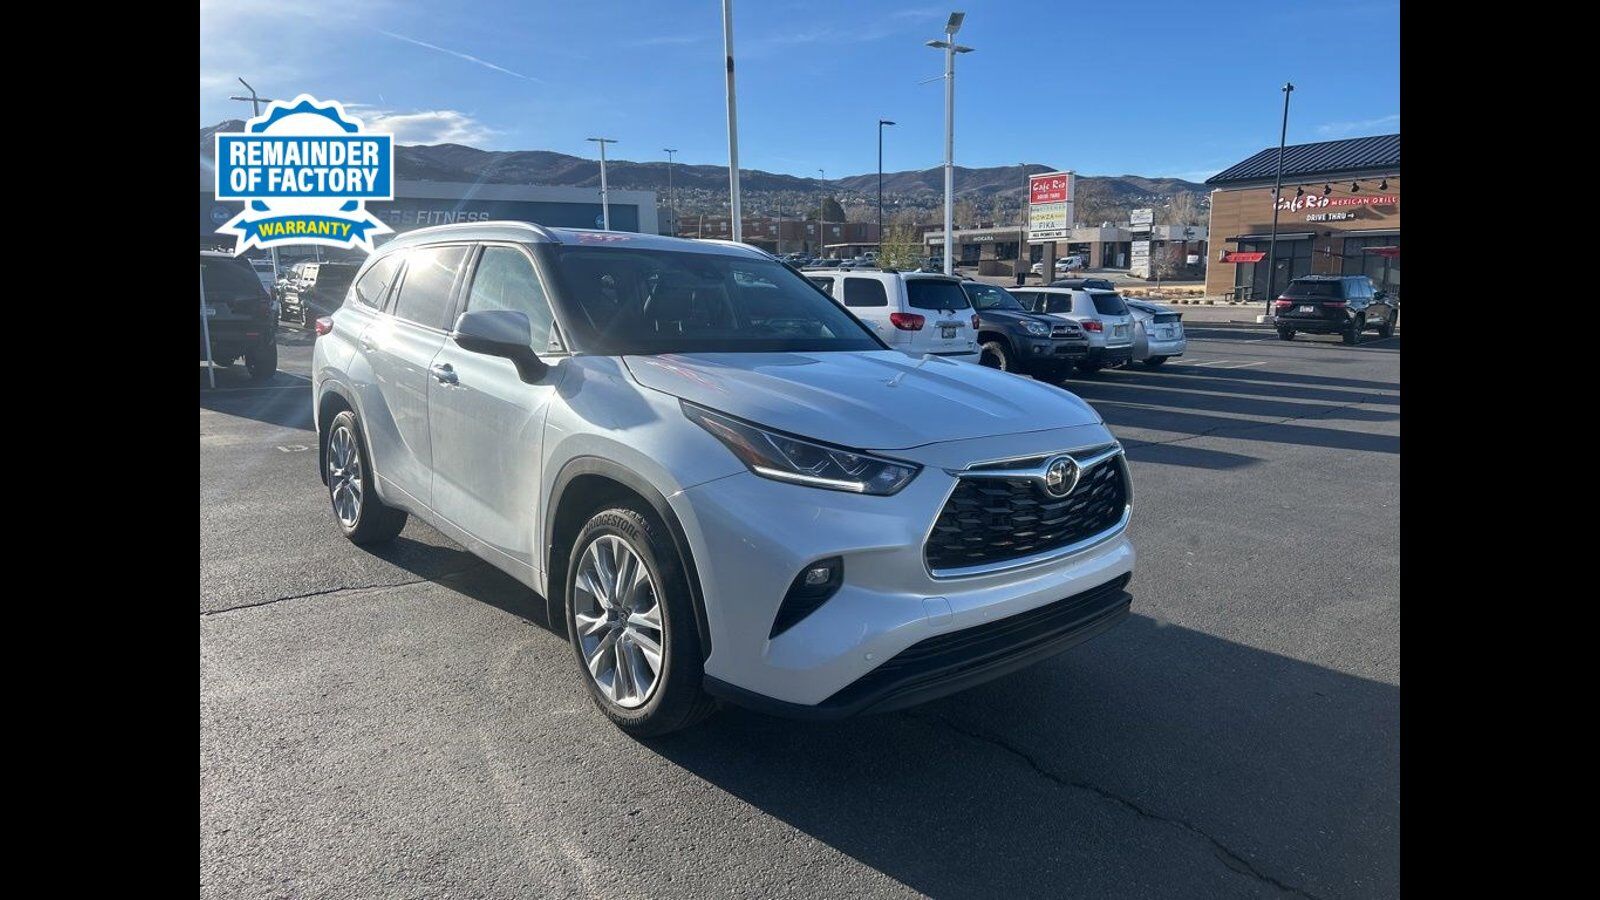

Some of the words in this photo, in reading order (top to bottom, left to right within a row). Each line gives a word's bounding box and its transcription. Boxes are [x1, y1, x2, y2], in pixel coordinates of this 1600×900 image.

[1273, 197, 1304, 212] Cafe
[1331, 198, 1369, 206] MEXICAN
[416, 210, 489, 224] FITNESS
[1306, 213, 1326, 222] DRIVE
[1328, 212, 1346, 221] THRU
